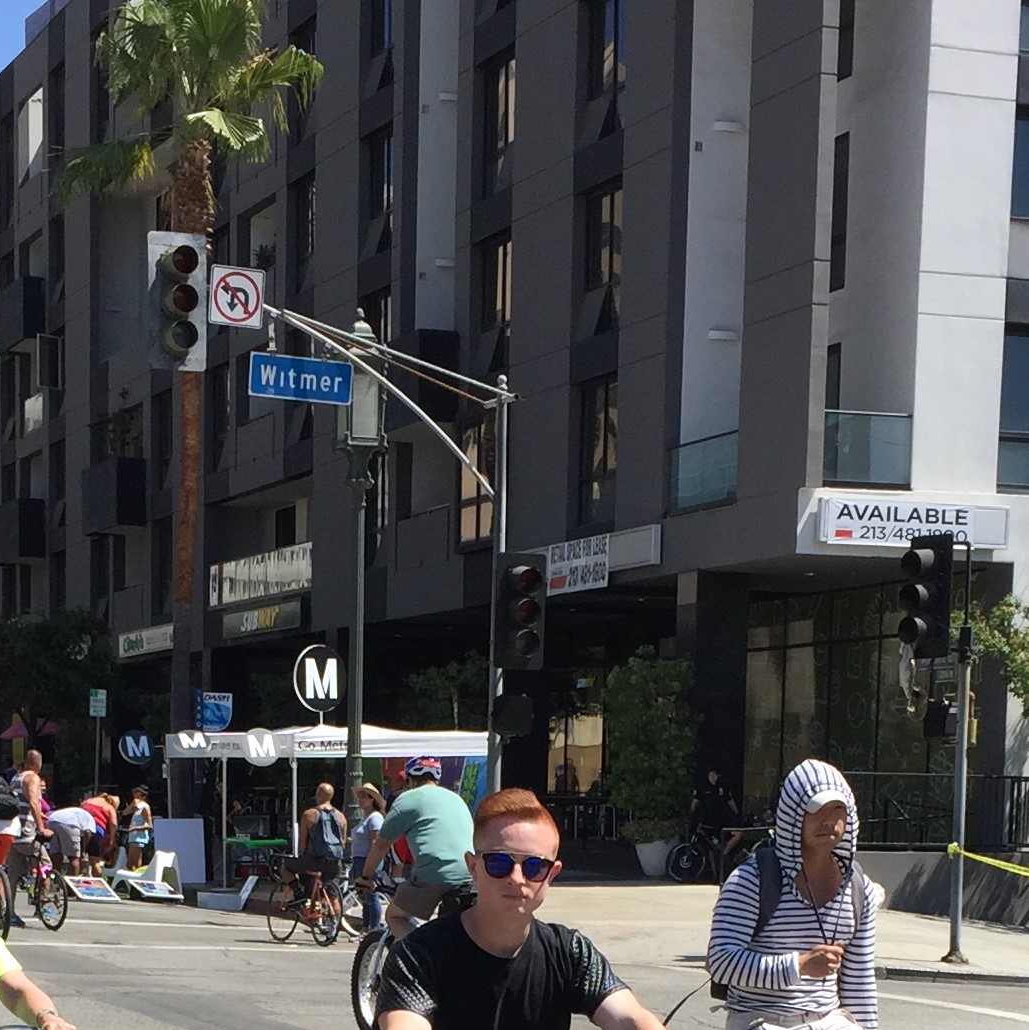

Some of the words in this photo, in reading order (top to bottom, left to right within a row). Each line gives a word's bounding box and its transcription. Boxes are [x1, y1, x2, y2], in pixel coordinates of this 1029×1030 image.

[260, 364, 343, 393] Witmer
[836, 504, 969, 526] AVAILABLE
[859, 525, 968, 543] 213/48110
[240, 605, 280, 632] SUBWAY
[305, 657, 338, 700] M
[204, 694, 230, 702] DASH
[125, 736, 150, 758] M
[177, 733, 207, 749] M
[246, 734, 276, 758] M
